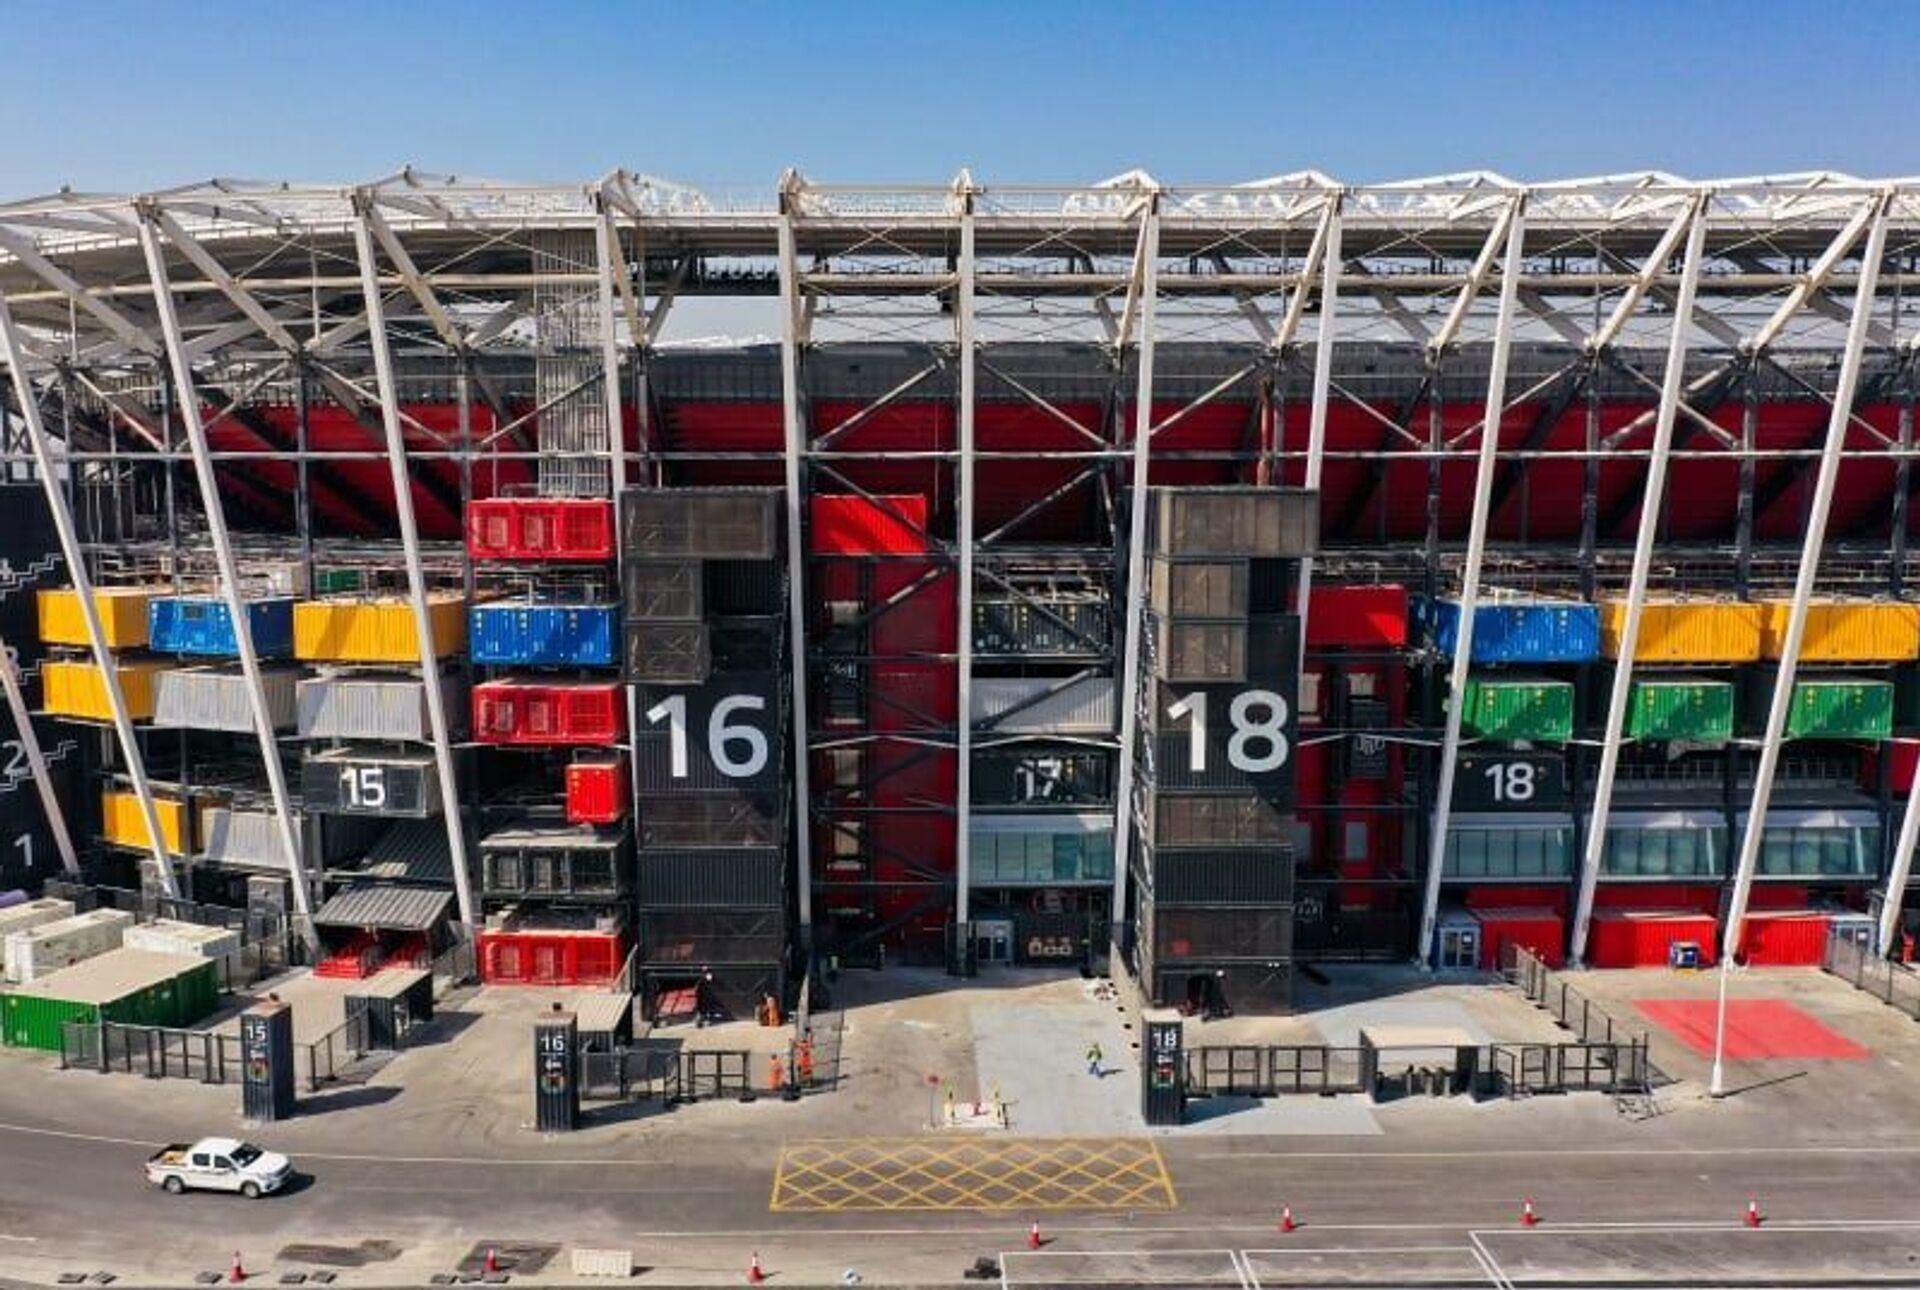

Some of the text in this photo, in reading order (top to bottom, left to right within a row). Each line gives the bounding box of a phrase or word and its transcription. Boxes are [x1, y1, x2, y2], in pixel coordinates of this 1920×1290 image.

[646, 694, 768, 777] 16
[1167, 690, 1289, 773] 18
[2, 741, 31, 774] 2
[341, 767, 386, 806] 15
[1016, 759, 1062, 800] 17
[1485, 762, 1534, 800] 18
[14, 833, 33, 866] 1
[245, 1023, 267, 1041] 15
[541, 1034, 564, 1051] 16
[1153, 1029, 1177, 1048] 18
